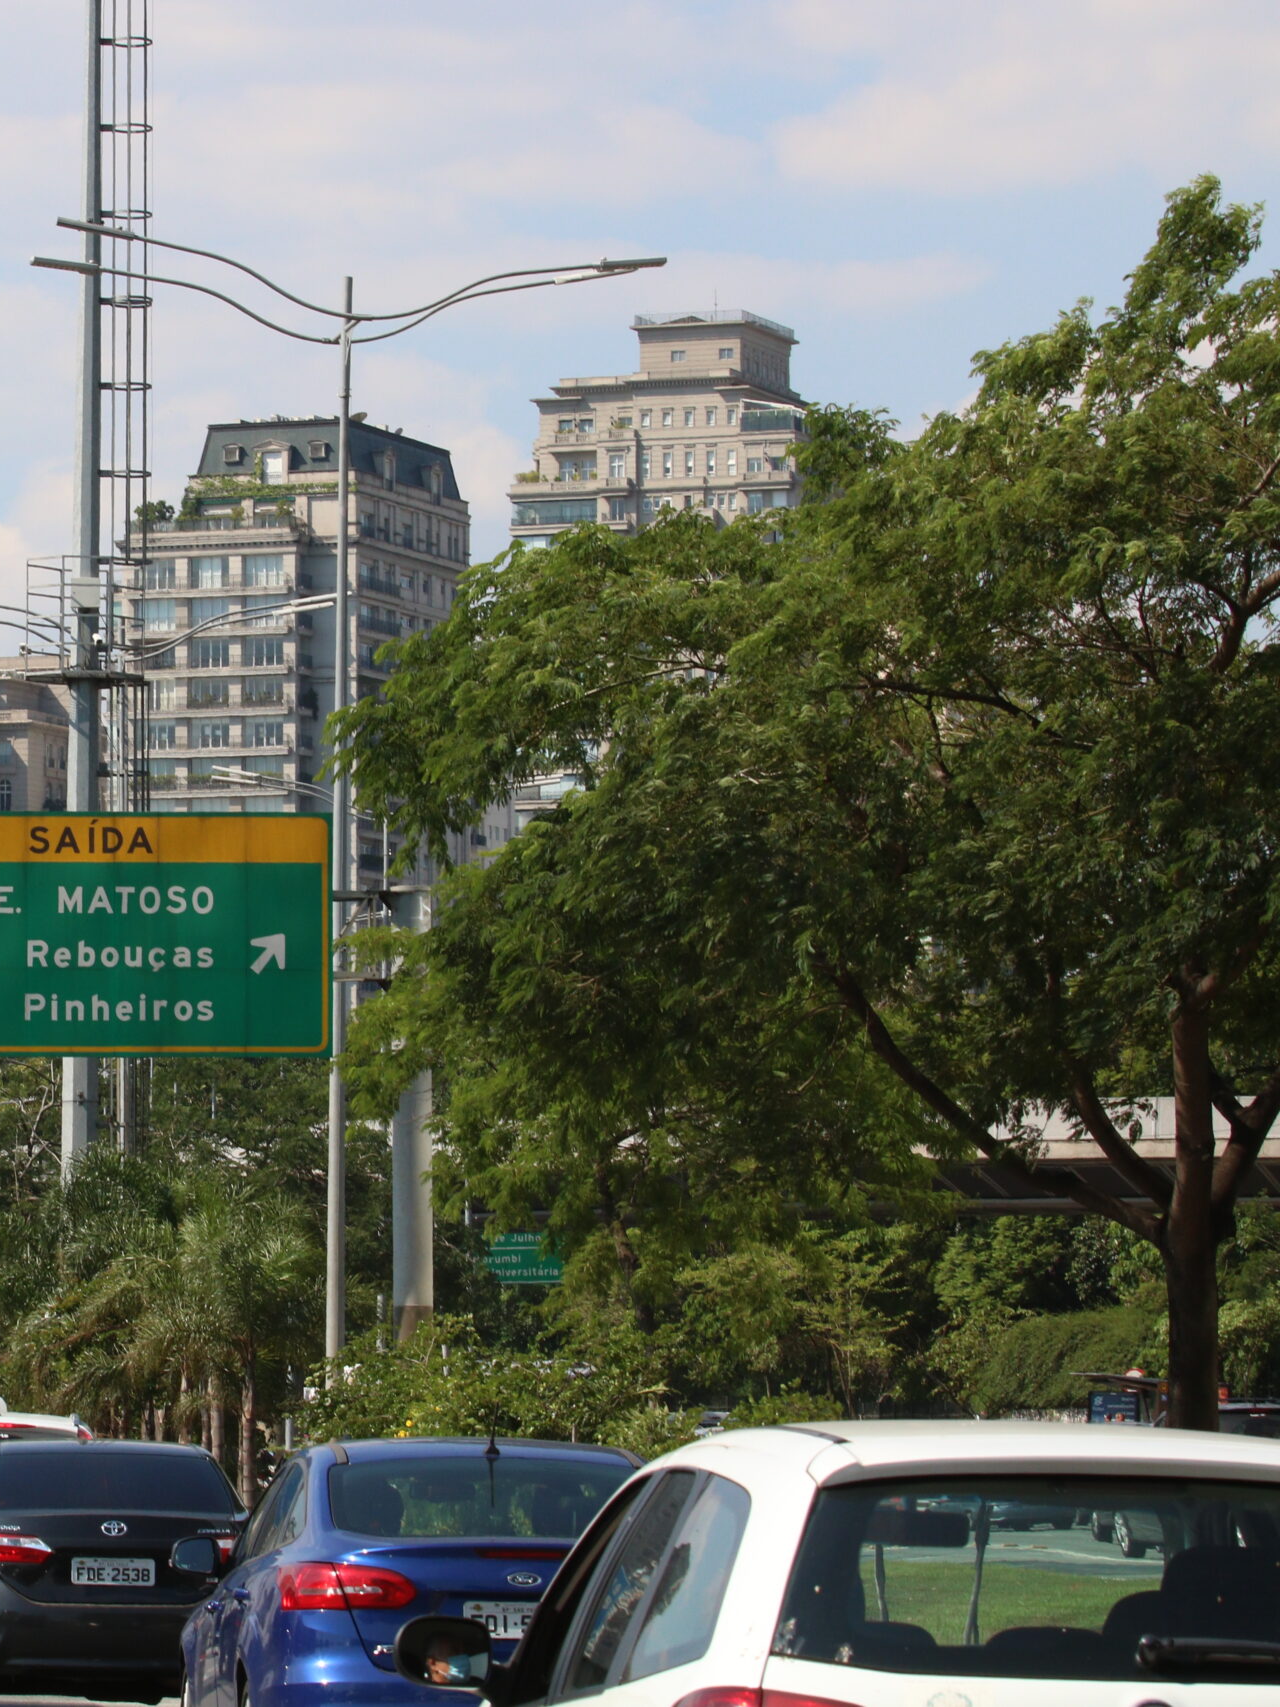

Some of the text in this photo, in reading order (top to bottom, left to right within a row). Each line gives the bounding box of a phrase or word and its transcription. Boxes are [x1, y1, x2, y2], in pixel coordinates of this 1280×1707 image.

[29, 819, 153, 854] SAÍDA
[57, 886, 215, 915] MATOSO
[27, 939, 214, 973] Rebouças
[24, 993, 214, 1022] Pinheiros
[511, 1234, 542, 1243] Julho
